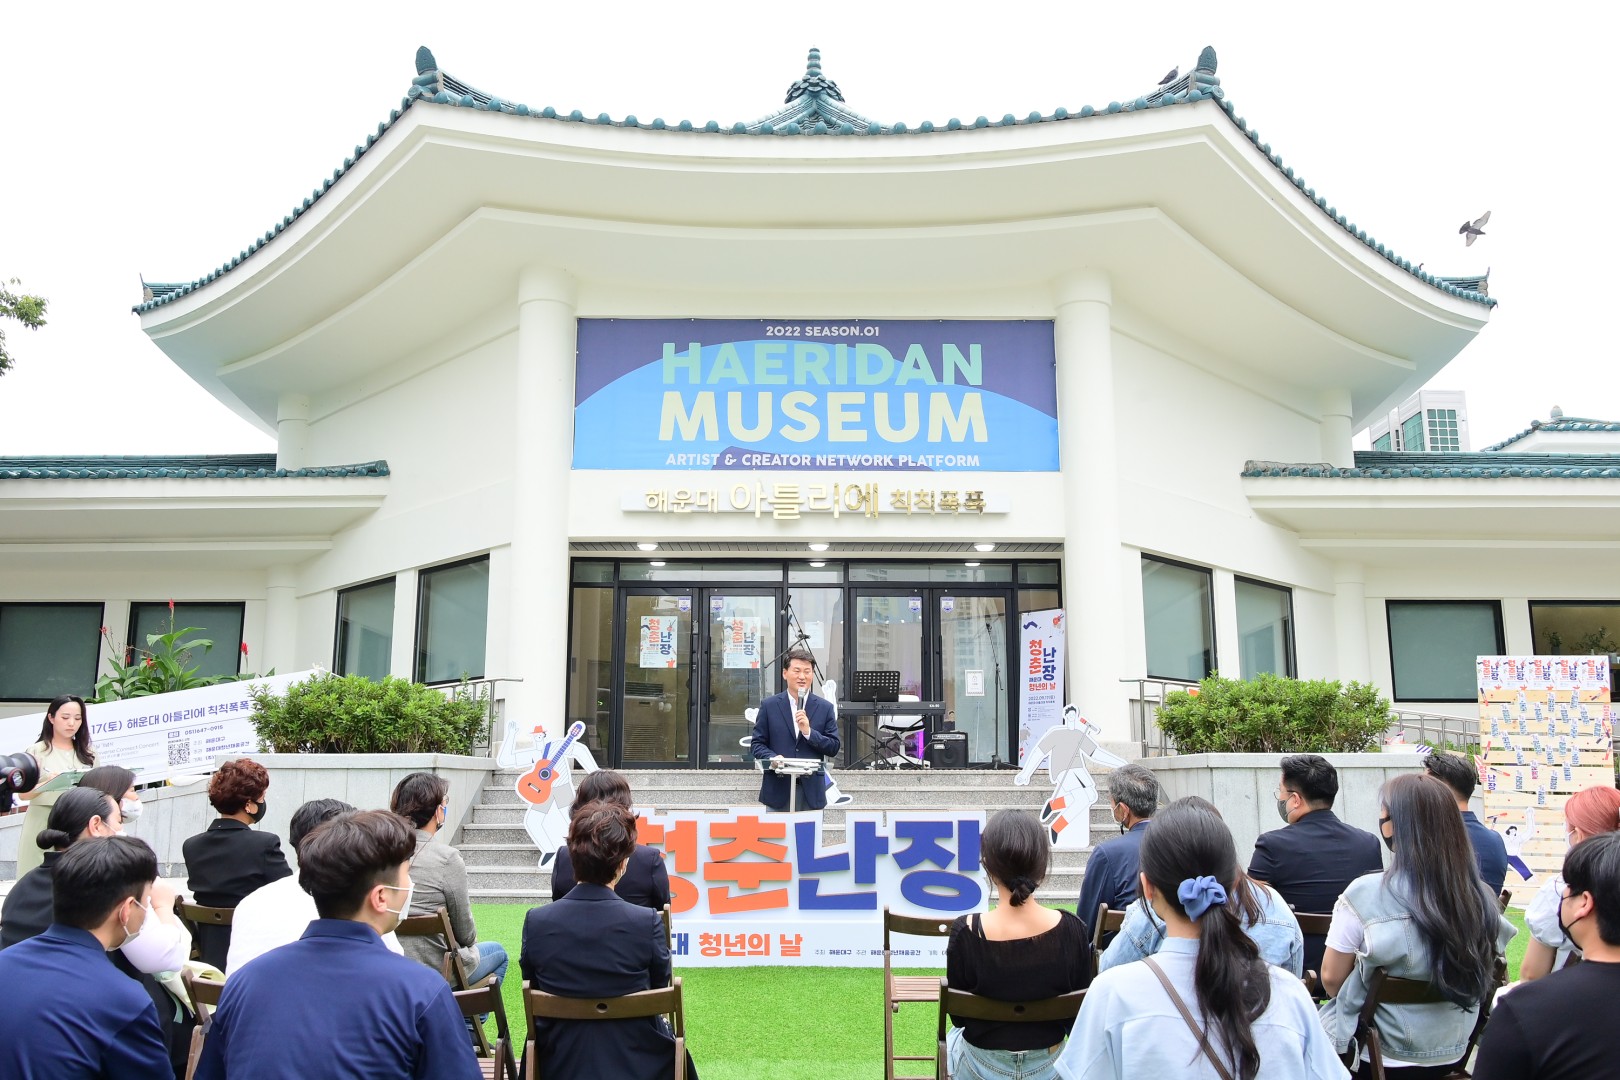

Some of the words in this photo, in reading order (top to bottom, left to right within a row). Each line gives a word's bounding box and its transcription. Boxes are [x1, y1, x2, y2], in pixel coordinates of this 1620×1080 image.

[765, 326, 801, 337] 2022
[804, 326, 880, 337] SEASON.01
[662, 342, 983, 386] HAERIDAN
[658, 390, 989, 443] MUSEUM
[665, 453, 720, 466] ARTIST
[724, 453, 737, 466] &
[741, 453, 811, 467] CREATOR
[815, 454, 894, 467] NETWORK
[898, 454, 980, 467] PLATFORM
[644, 487, 719, 514] 해운대
[729, 482, 879, 520] 아틀리에
[890, 488, 987, 515] 칙칙폭폭
[1028, 639, 1043, 675] 청춘
[1041, 647, 1056, 681] 난장
[126, 714, 160, 730] 해운대
[162, 707, 206, 724] 아틀리에
[207, 700, 250, 715] 칙칙폭폭
[698, 932, 772, 958] 청년의
[780, 932, 803, 957] 날
